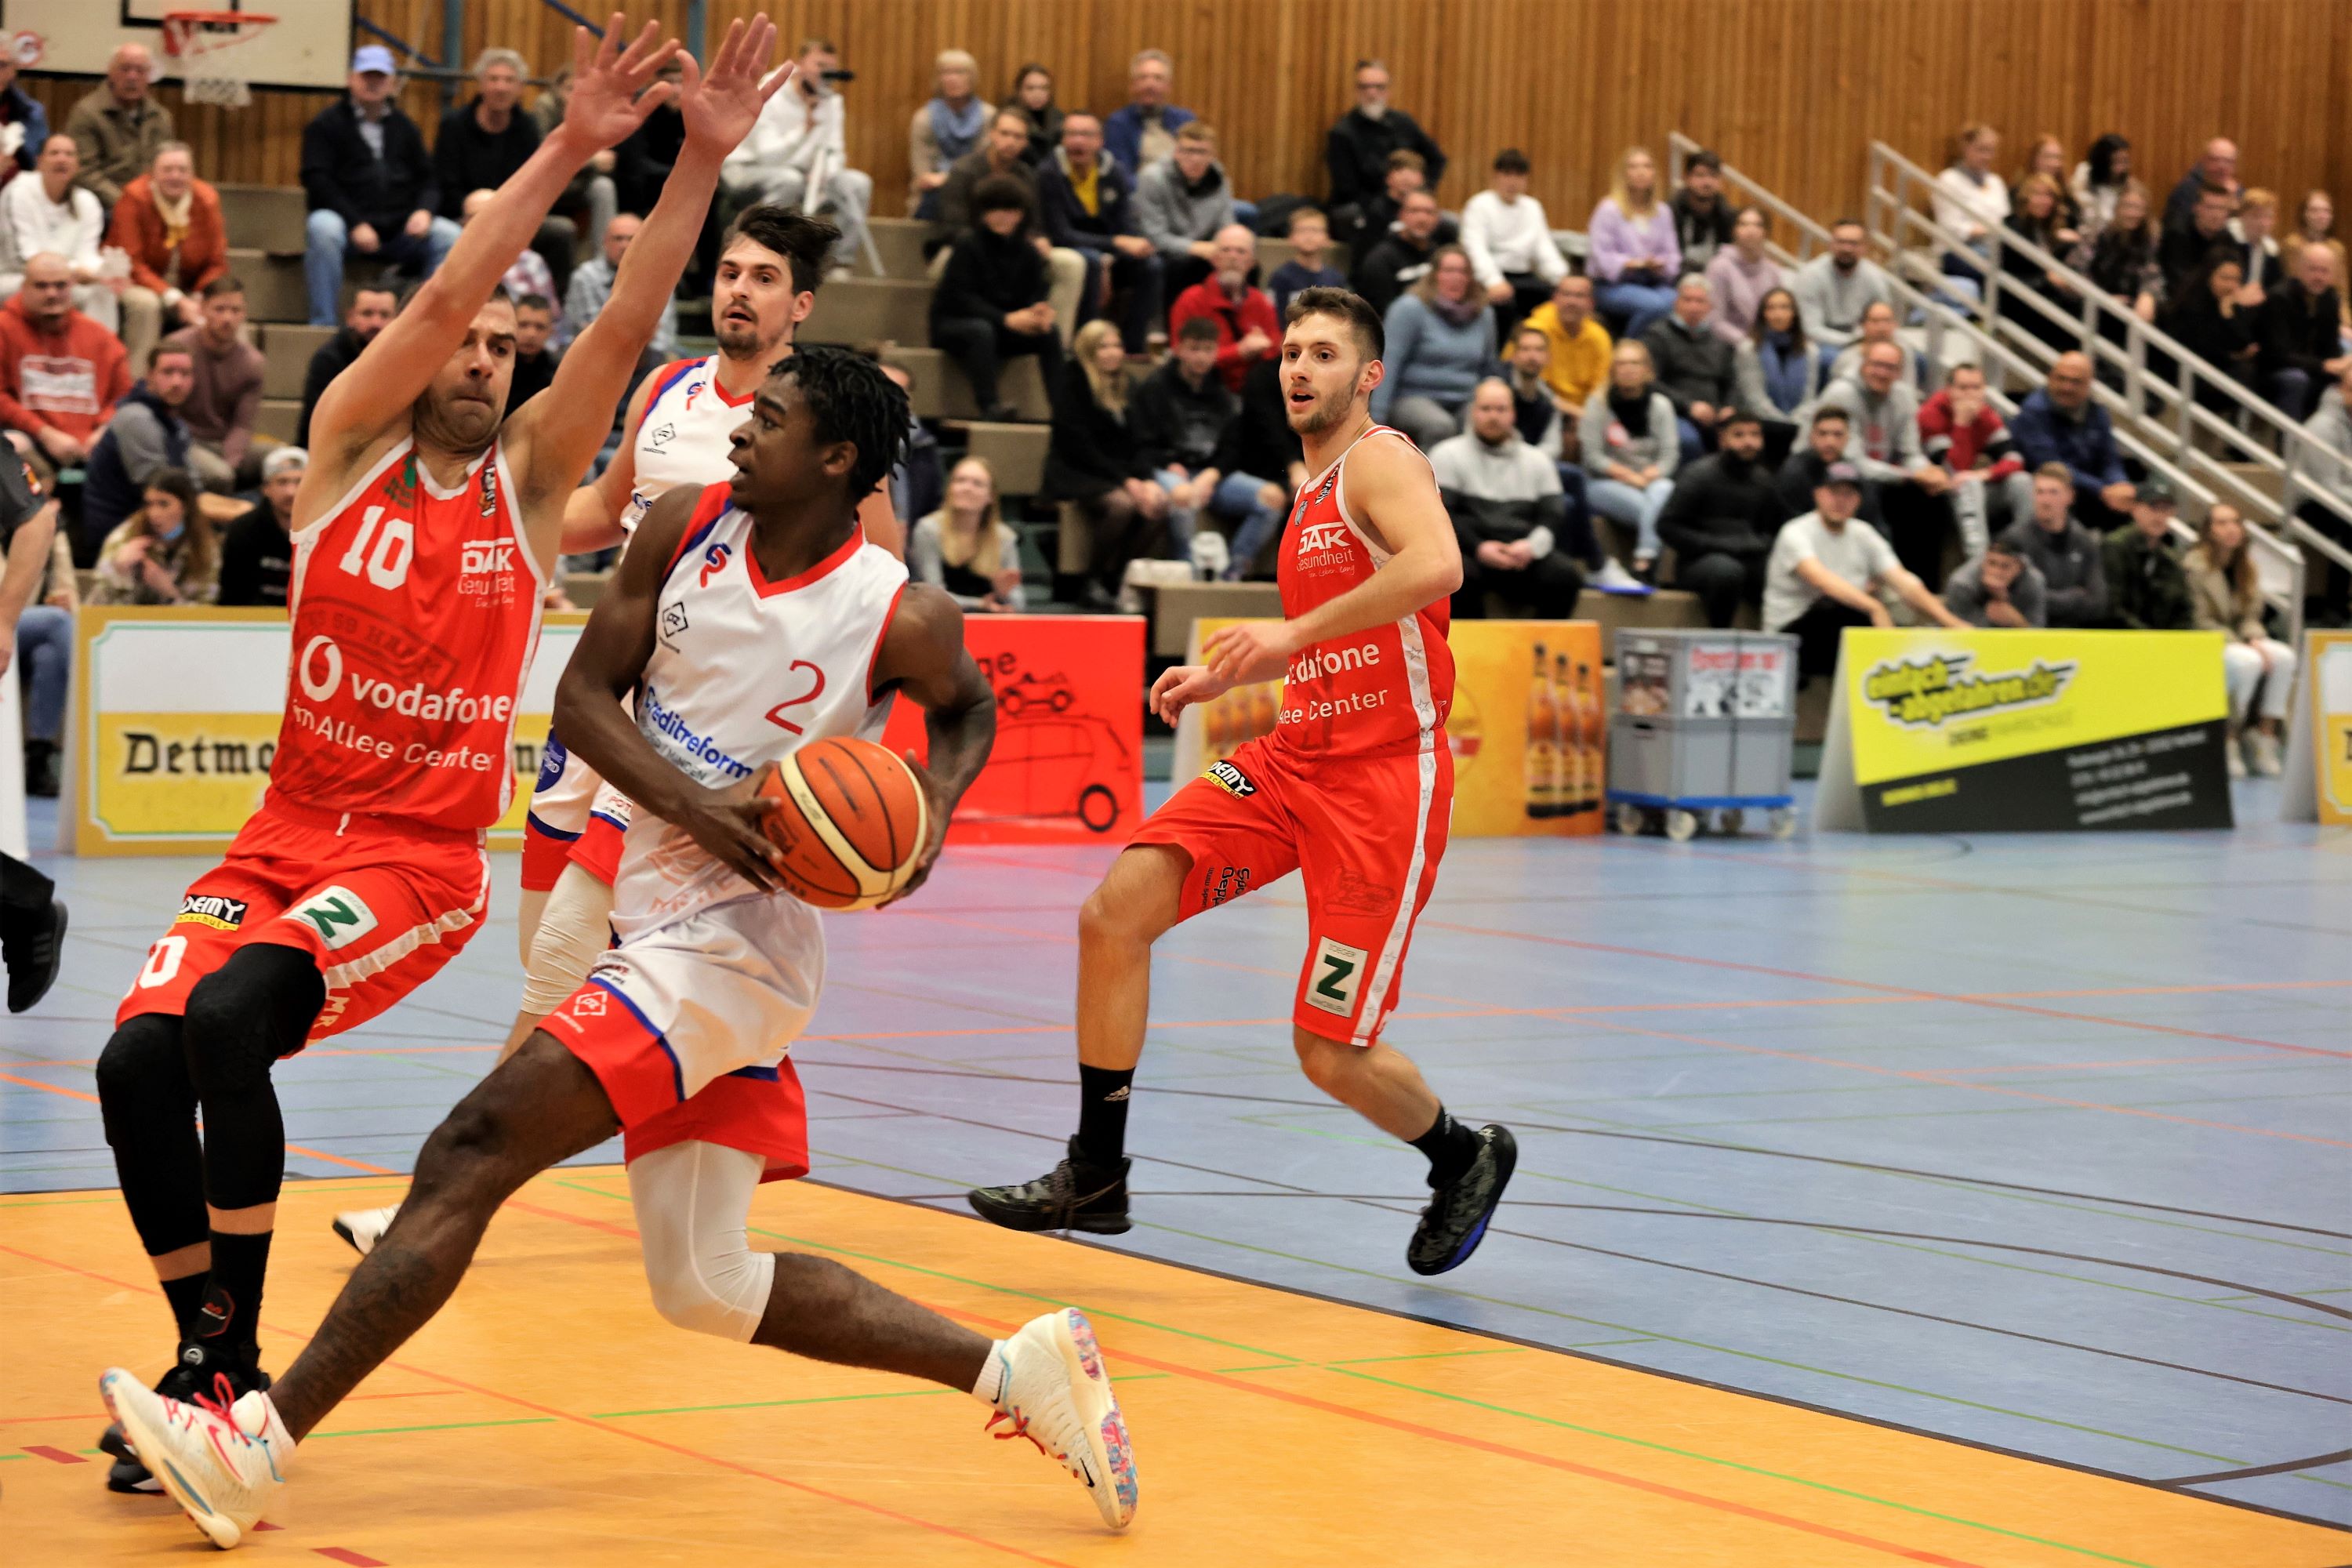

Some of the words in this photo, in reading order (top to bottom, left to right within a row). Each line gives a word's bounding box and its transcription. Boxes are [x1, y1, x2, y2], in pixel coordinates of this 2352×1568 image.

[339, 505, 413, 590] 10
[461, 537, 515, 574] DAK
[976, 652, 1016, 684] ge
[765, 660, 826, 735] 2
[1309, 690, 1388, 720] Center
[124, 732, 274, 774] Detmo
[315, 716, 394, 759] Allee
[303, 896, 360, 938] Z
[1317, 954, 1355, 1001] Z
